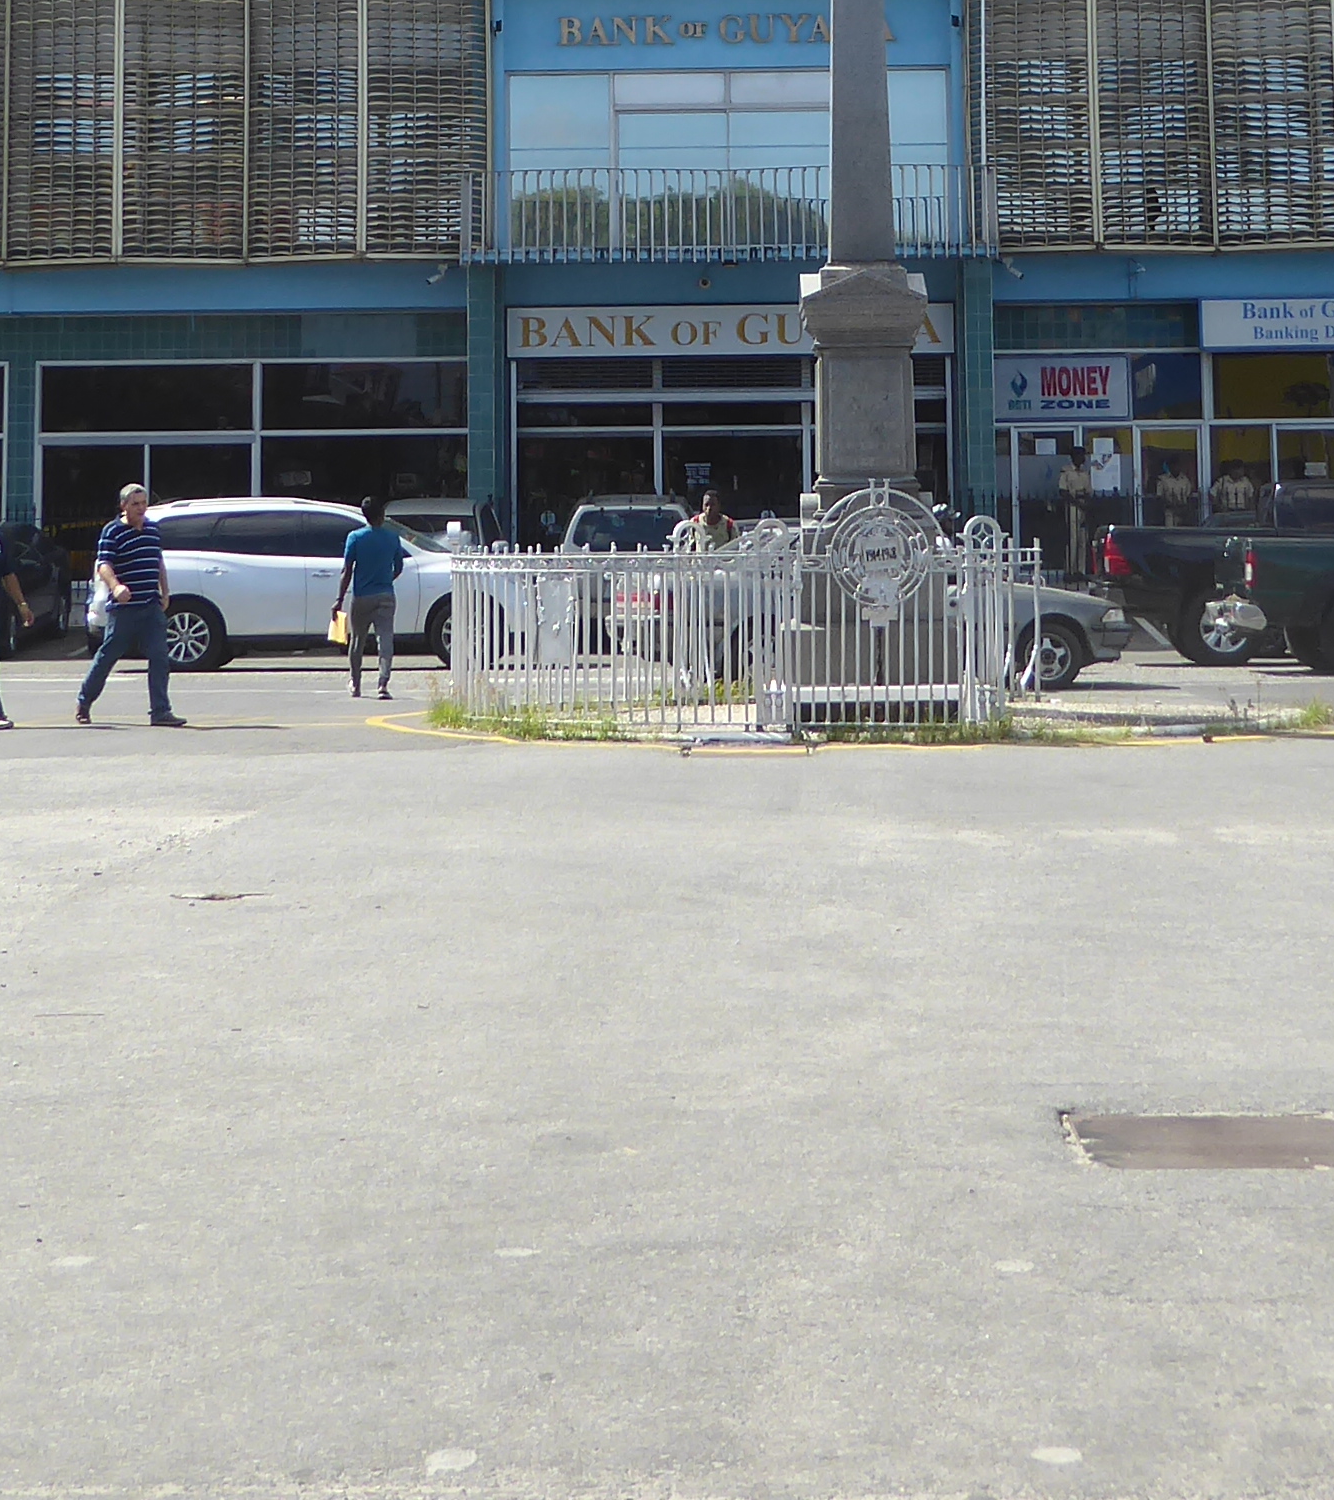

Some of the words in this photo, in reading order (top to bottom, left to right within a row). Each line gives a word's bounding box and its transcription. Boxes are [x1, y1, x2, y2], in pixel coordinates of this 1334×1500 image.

[558, 14, 672, 46] BANK
[719, 12, 897, 44] GUYA
[1242, 302, 1294, 320] Bank
[1299, 305, 1315, 318] of
[517, 314, 656, 348] BANK
[670, 320, 722, 346] OF
[1253, 325, 1319, 342] Banking
[1040, 366, 1111, 396] MONEY
[1040, 399, 1110, 410] ZONE
